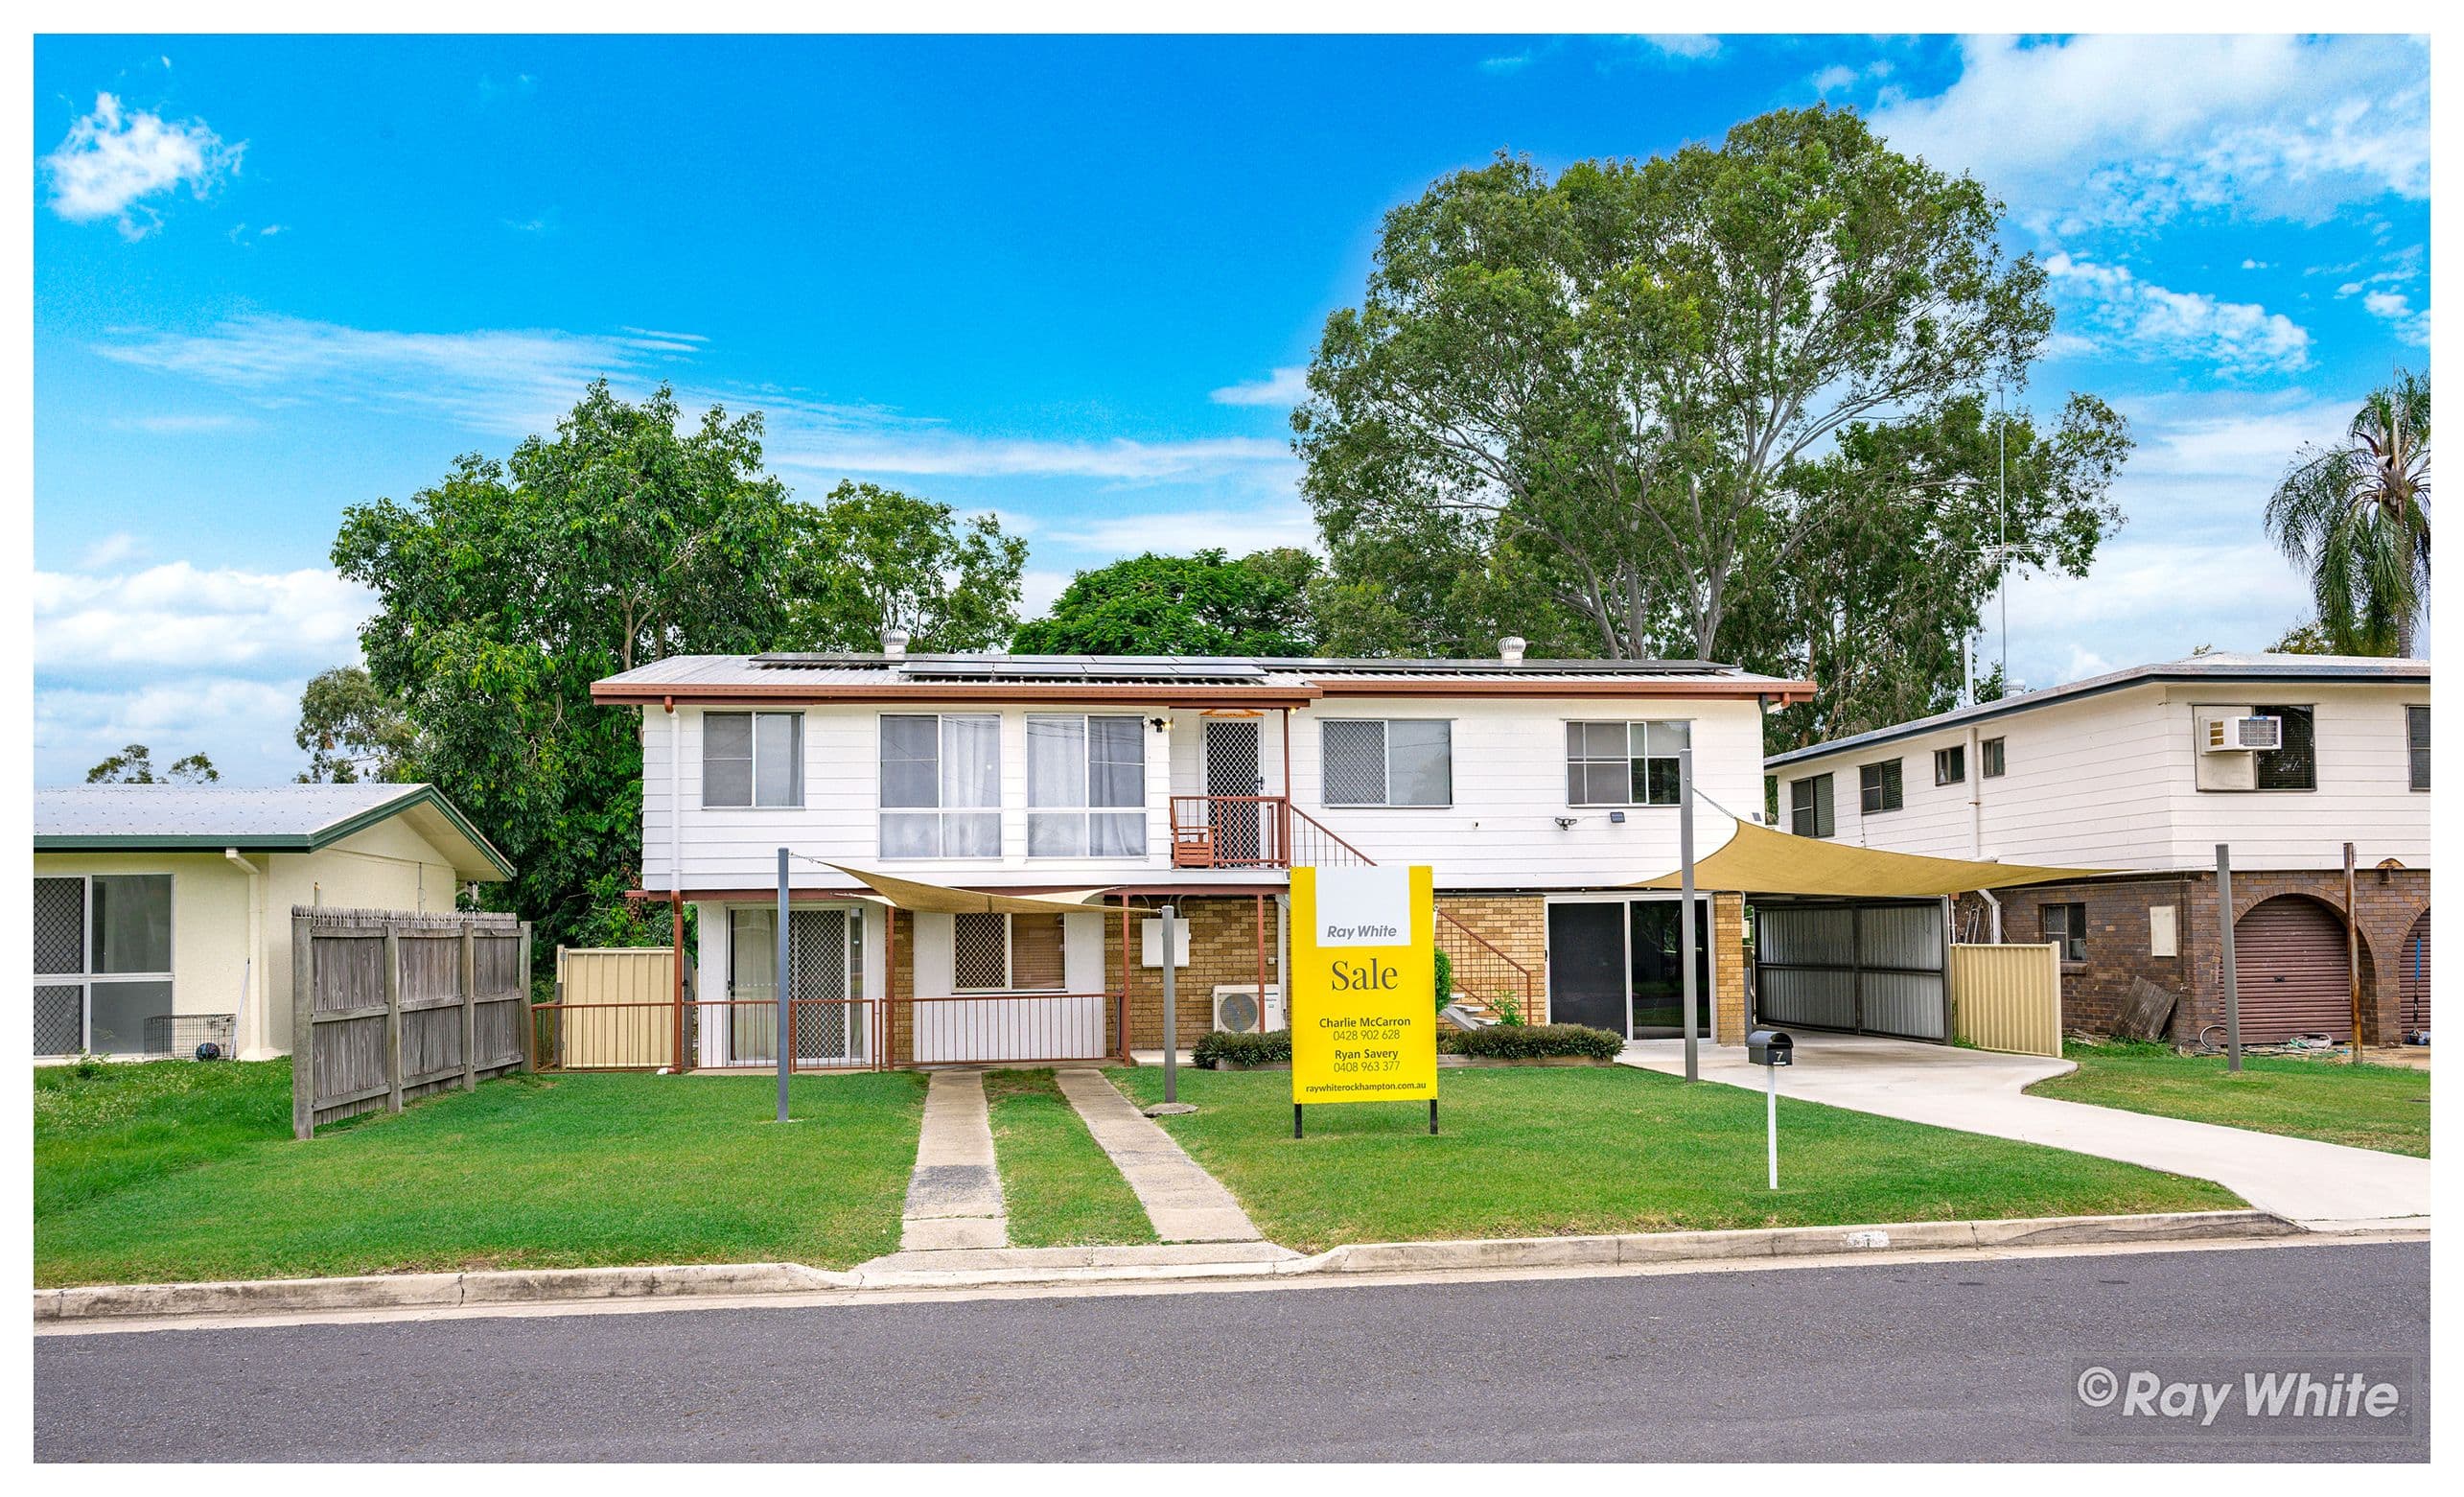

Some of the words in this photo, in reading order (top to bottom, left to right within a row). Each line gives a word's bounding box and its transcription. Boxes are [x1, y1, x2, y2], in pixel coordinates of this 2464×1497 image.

[1327, 925, 1355, 940] Ray
[1358, 925, 1397, 937] White
[1332, 957, 1398, 991] Sale
[1319, 1017, 1357, 1028] Charlie
[1360, 1017, 1410, 1027] McCarron
[1333, 1030, 1358, 1041] 0428
[1360, 1030, 1379, 1040] 902
[1382, 1029, 1400, 1040] 628
[1335, 1049, 1360, 1061] Ryan
[1364, 1049, 1398, 1060] Savery
[1776, 1051, 1783, 1061] 7
[1334, 1062, 1359, 1072] 0408
[1360, 1062, 1380, 1071] 963
[1383, 1061, 1400, 1071] 377
[1306, 1082, 1426, 1093] raywhiterockhampton.com.au
